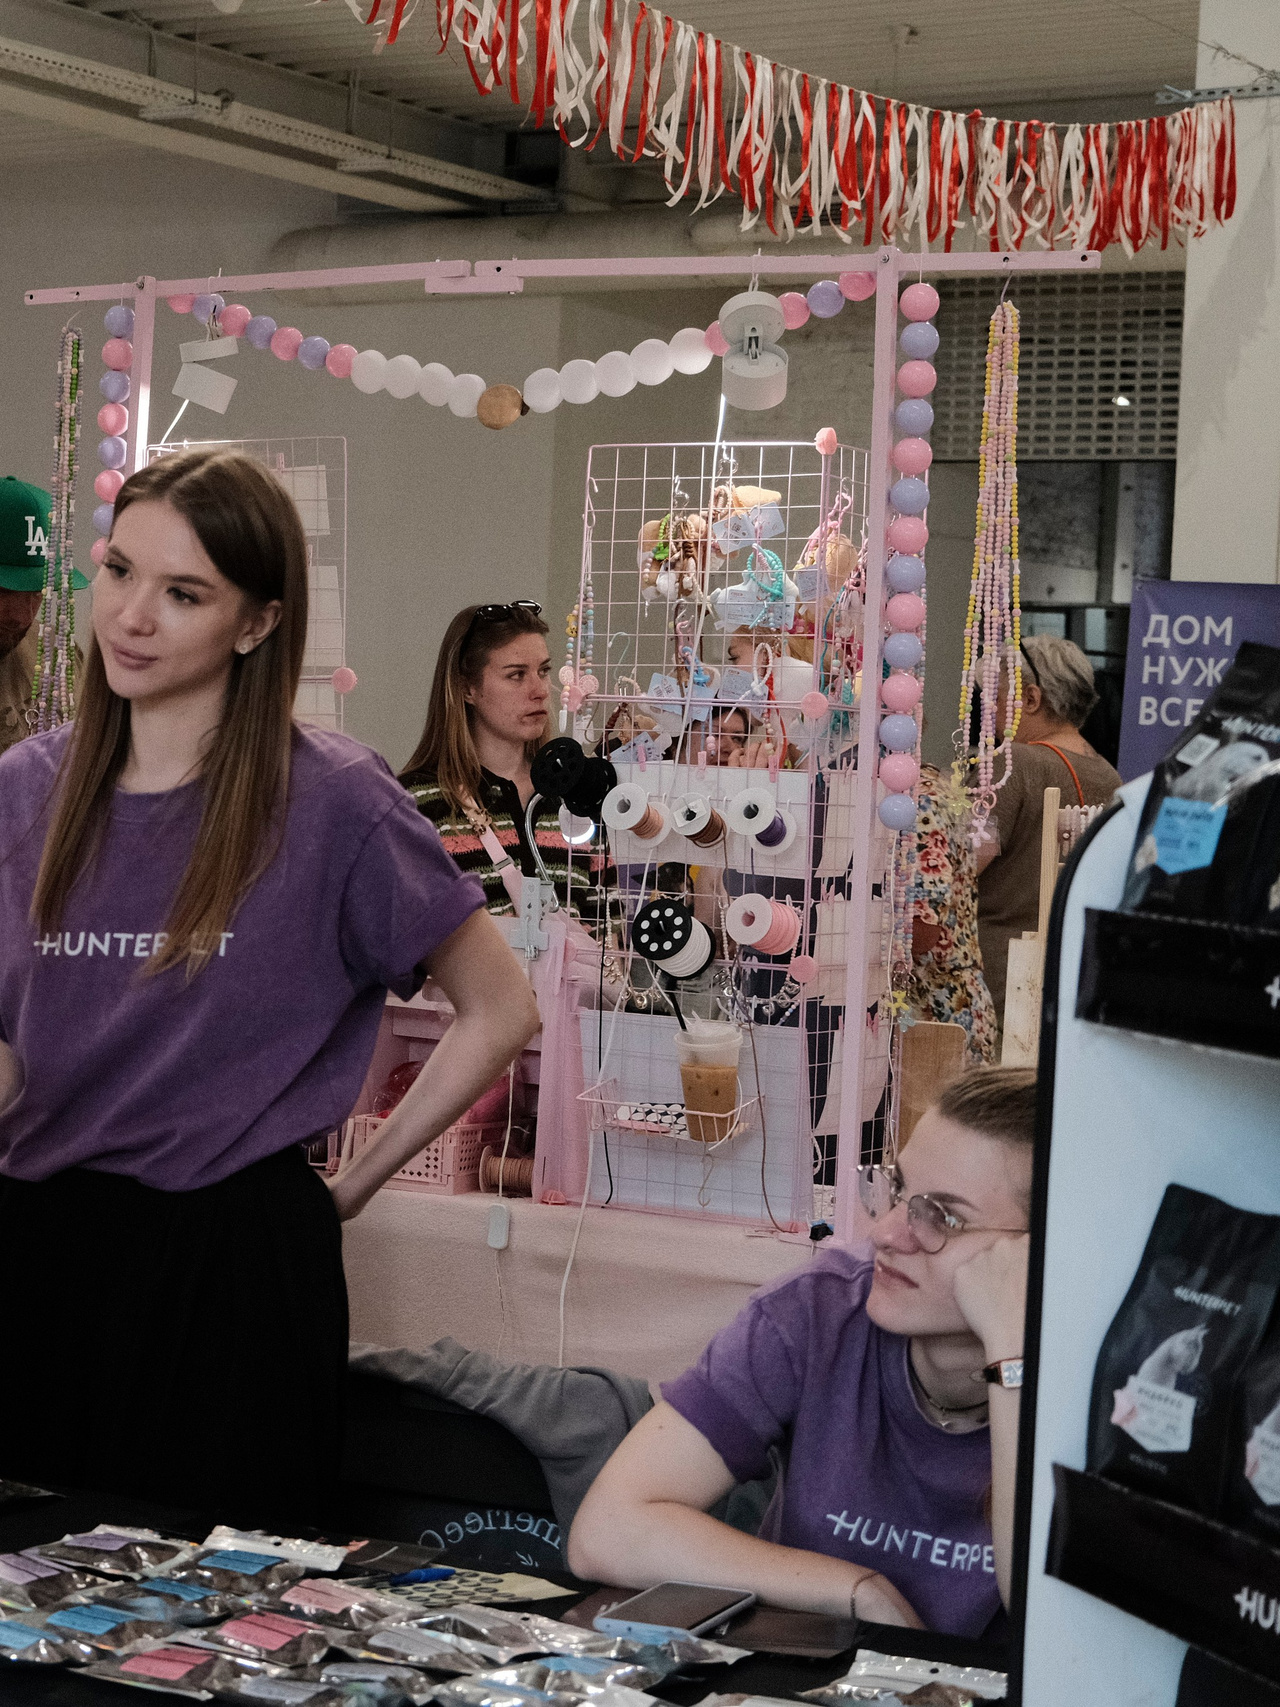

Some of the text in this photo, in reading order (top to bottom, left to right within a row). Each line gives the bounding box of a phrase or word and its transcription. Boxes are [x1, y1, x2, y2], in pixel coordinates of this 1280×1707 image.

[24, 515, 49, 556] LA
[1142, 614, 1234, 649] ДОМ
[1142, 655, 1236, 687] НУЖ
[1233, 1586, 1280, 1636] HU
